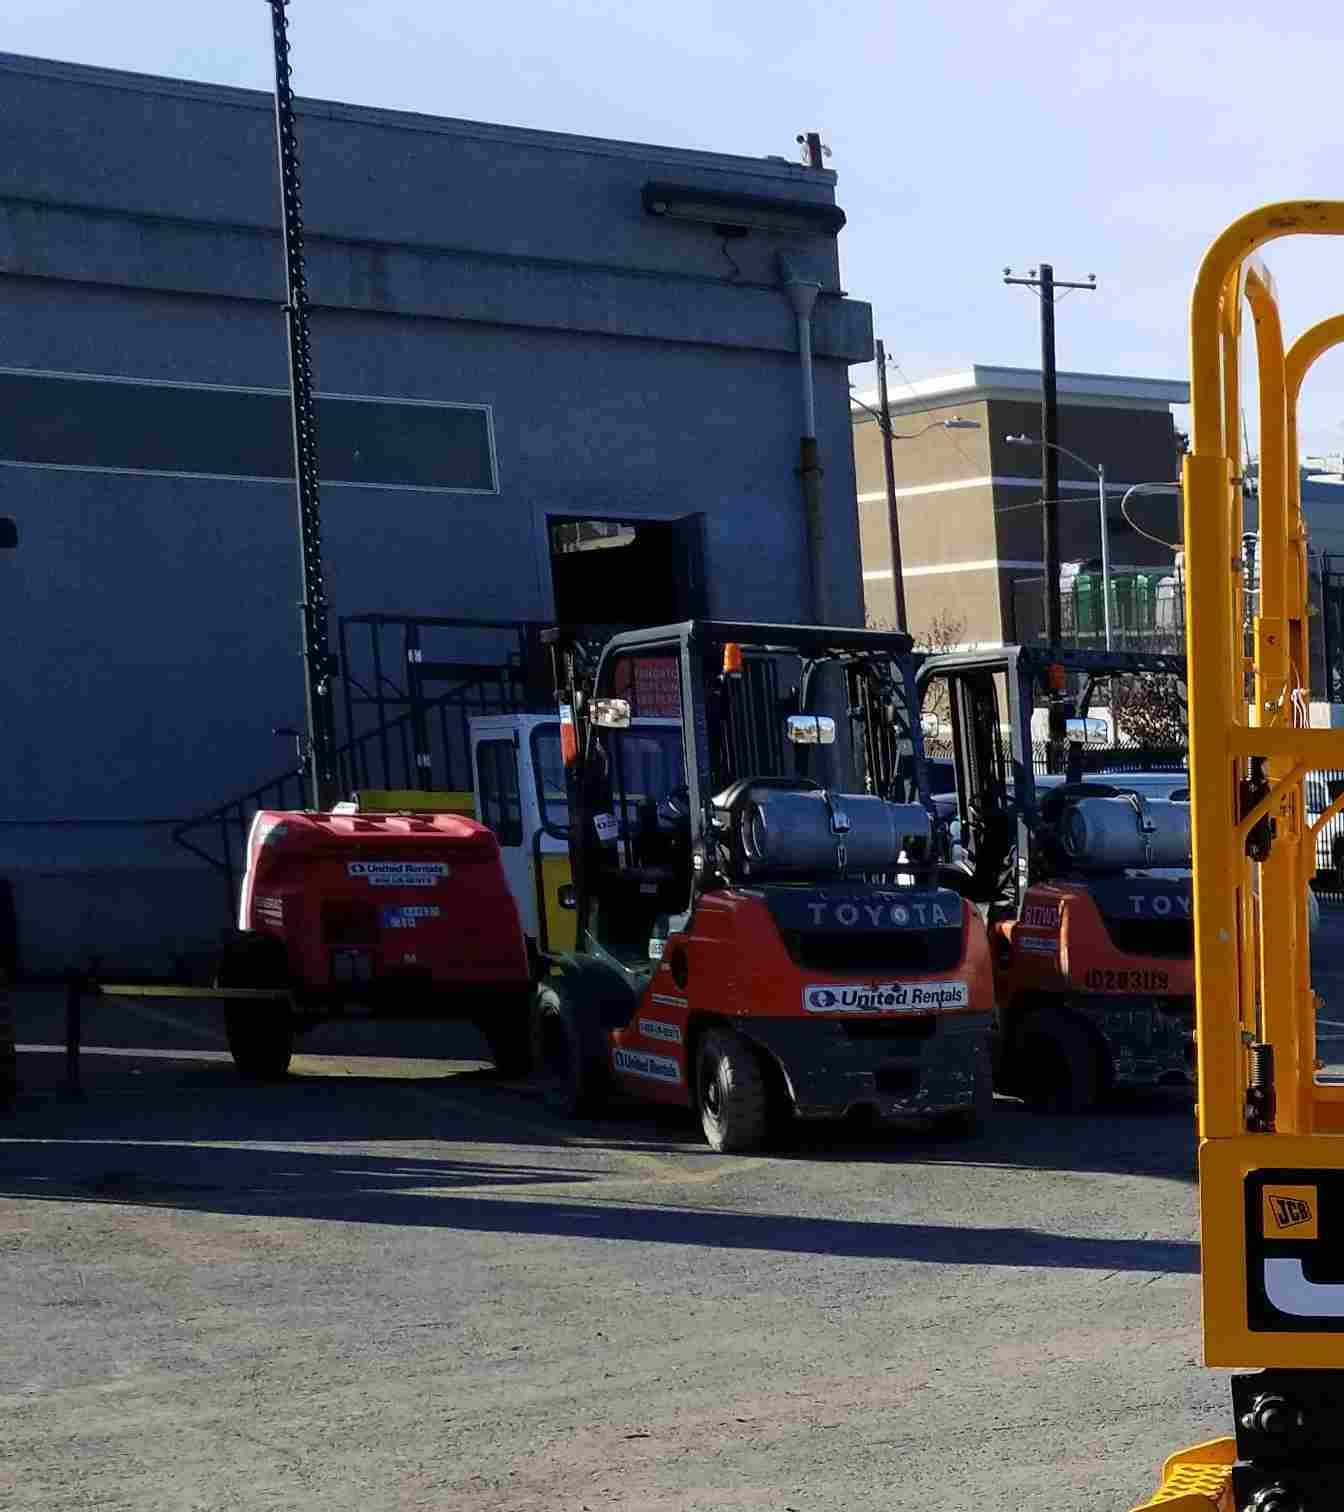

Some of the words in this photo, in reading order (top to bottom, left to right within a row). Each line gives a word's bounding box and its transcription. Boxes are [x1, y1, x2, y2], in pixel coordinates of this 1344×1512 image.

[807, 903, 948, 927] TOYOTA
[841, 987, 908, 1009] United
[911, 986, 963, 1006] Rentals
[1277, 1199, 1311, 1224] JCB
